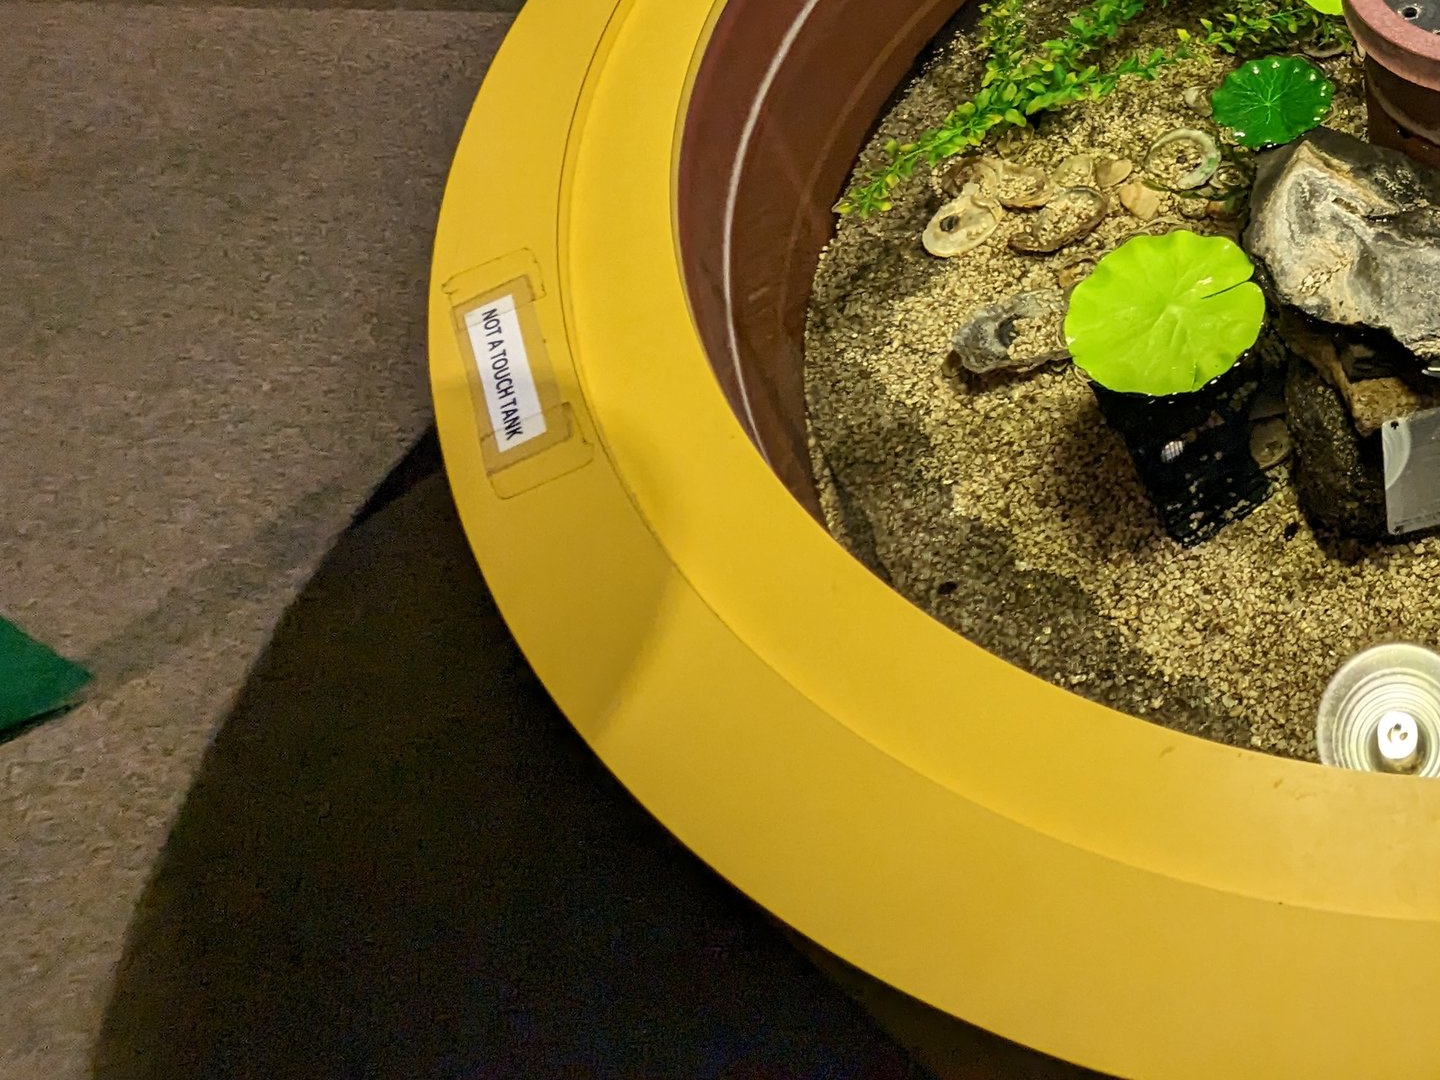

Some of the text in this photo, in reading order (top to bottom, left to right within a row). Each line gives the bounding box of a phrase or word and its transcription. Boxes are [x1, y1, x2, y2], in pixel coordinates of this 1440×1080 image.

[481, 308, 524, 441] NOT A TOUCH TANK
